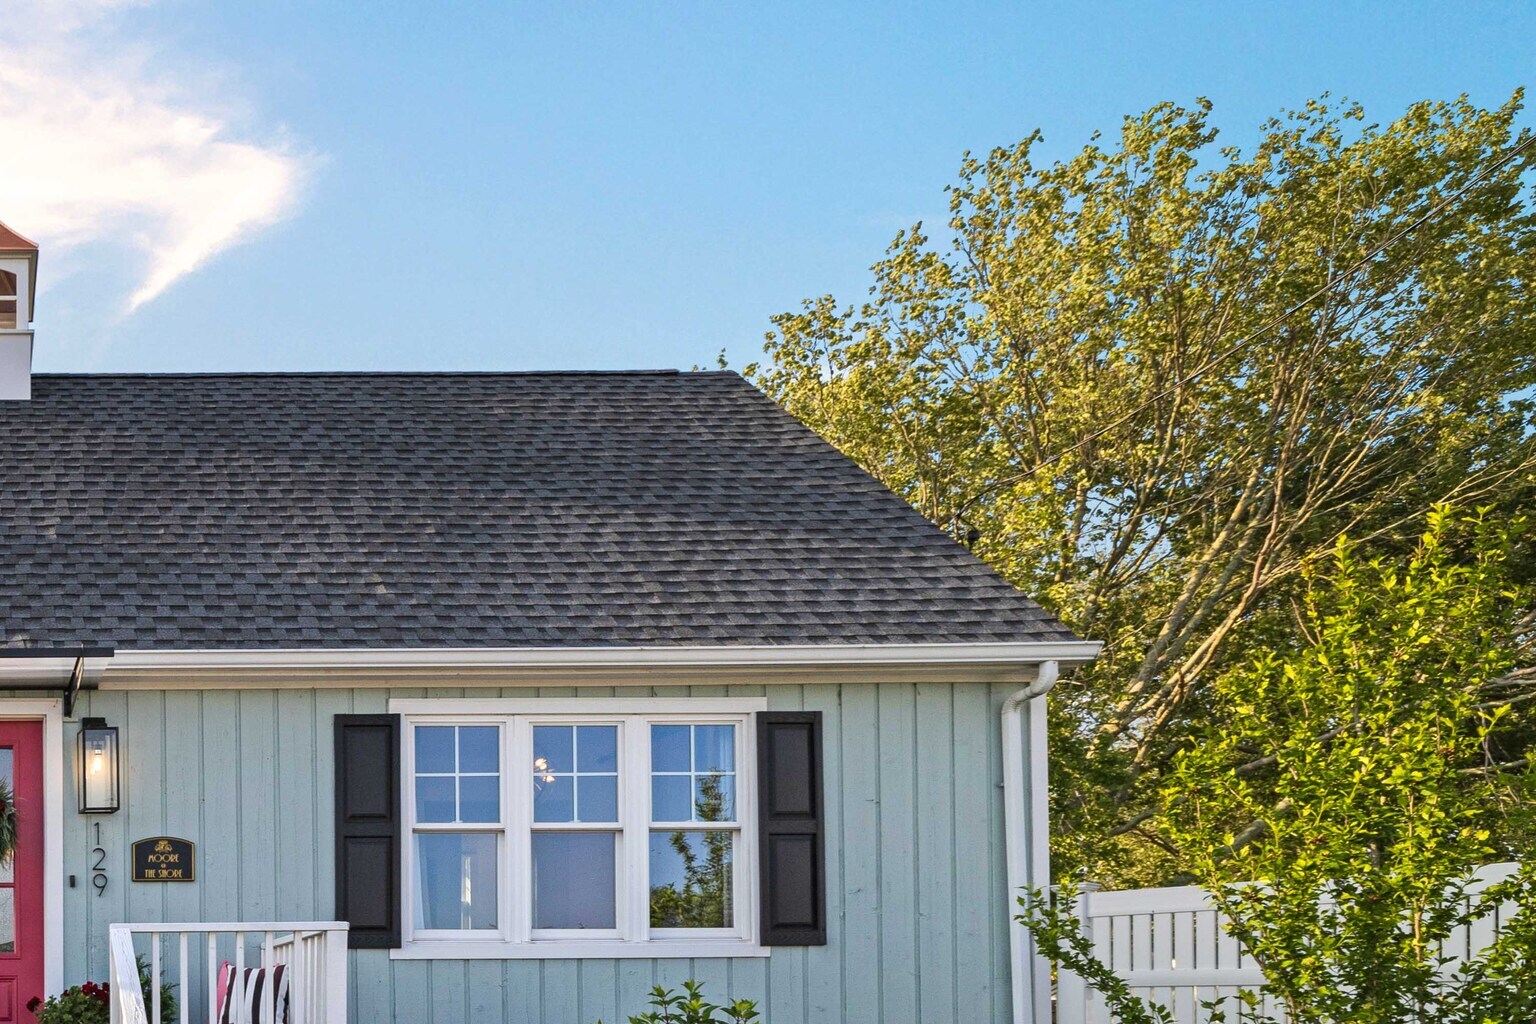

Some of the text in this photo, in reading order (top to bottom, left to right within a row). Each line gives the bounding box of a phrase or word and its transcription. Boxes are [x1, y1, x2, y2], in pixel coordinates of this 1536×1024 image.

[92, 822, 108, 897] 129
[148, 854, 179, 862] MOORE
[145, 869, 182, 878] THE SHORE
